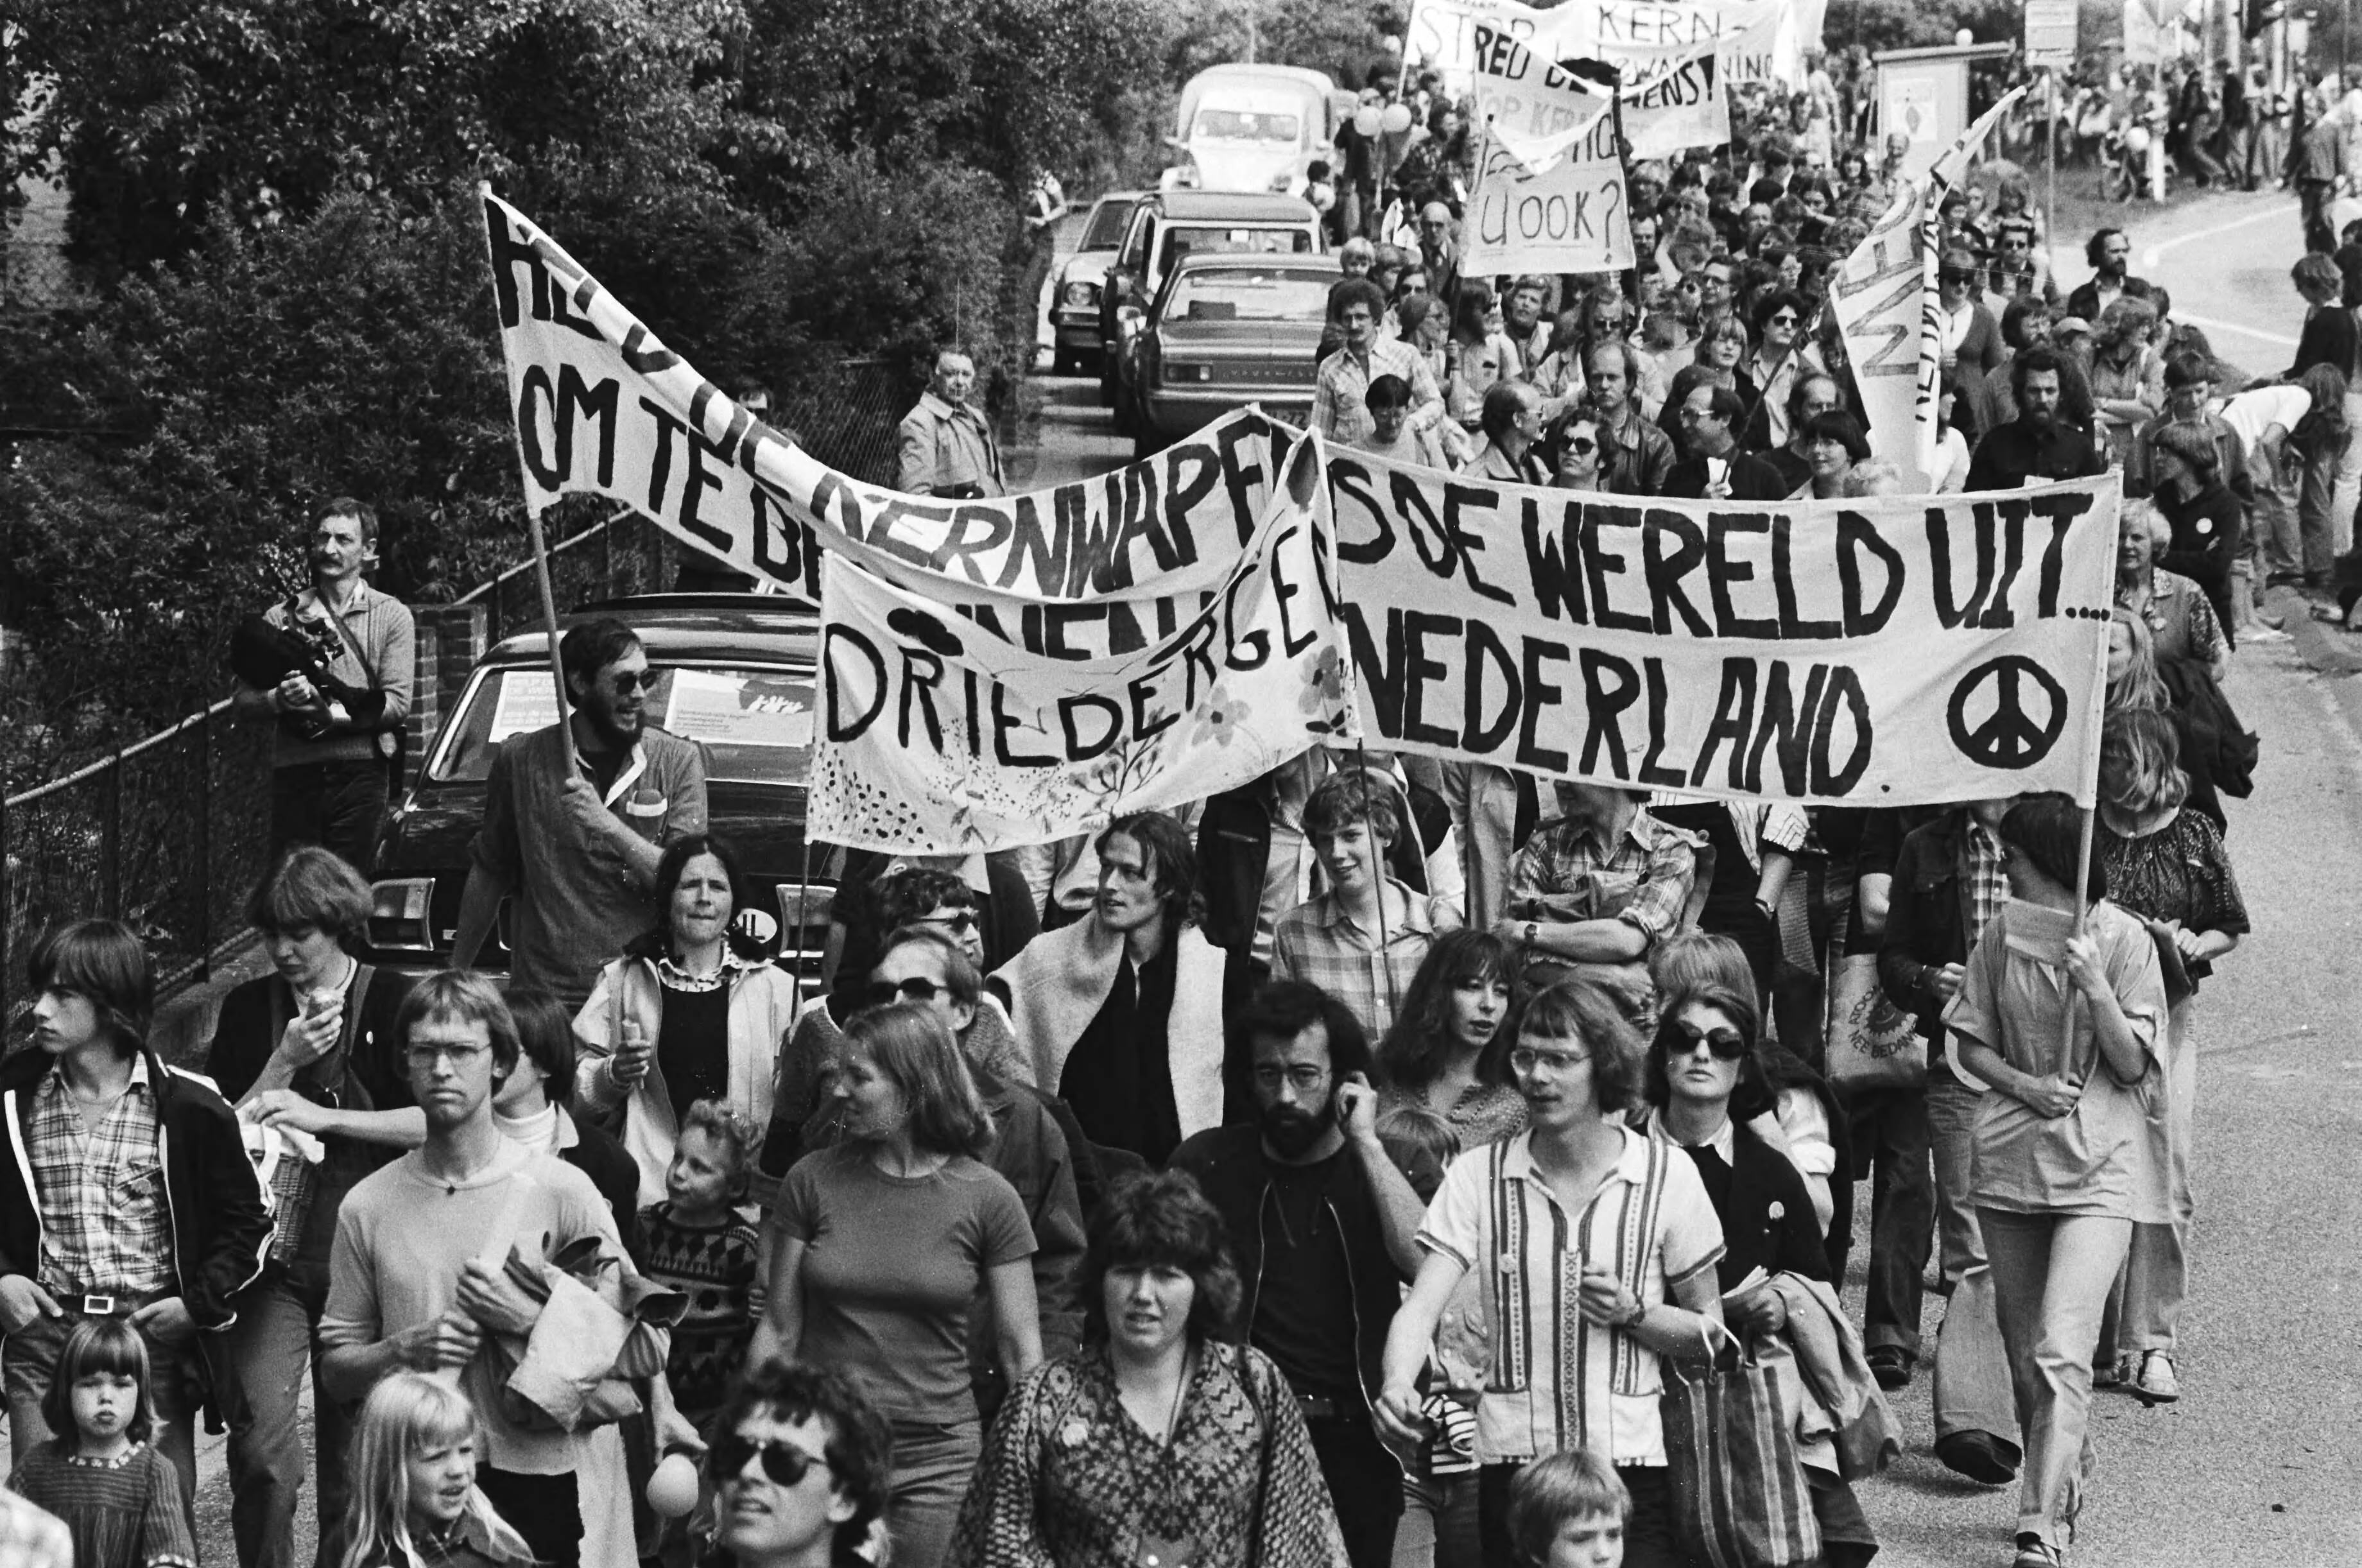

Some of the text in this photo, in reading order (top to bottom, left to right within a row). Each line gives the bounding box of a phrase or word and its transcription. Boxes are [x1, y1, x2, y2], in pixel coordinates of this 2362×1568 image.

[1518, 179, 1621, 264] OOK?
[518, 363, 621, 493] OM
[639, 395, 734, 555] TE
[810, 415, 1397, 599] KERNWAPES
[1388, 469, 1517, 608] DE
[1521, 496, 1906, 639] WERELD
